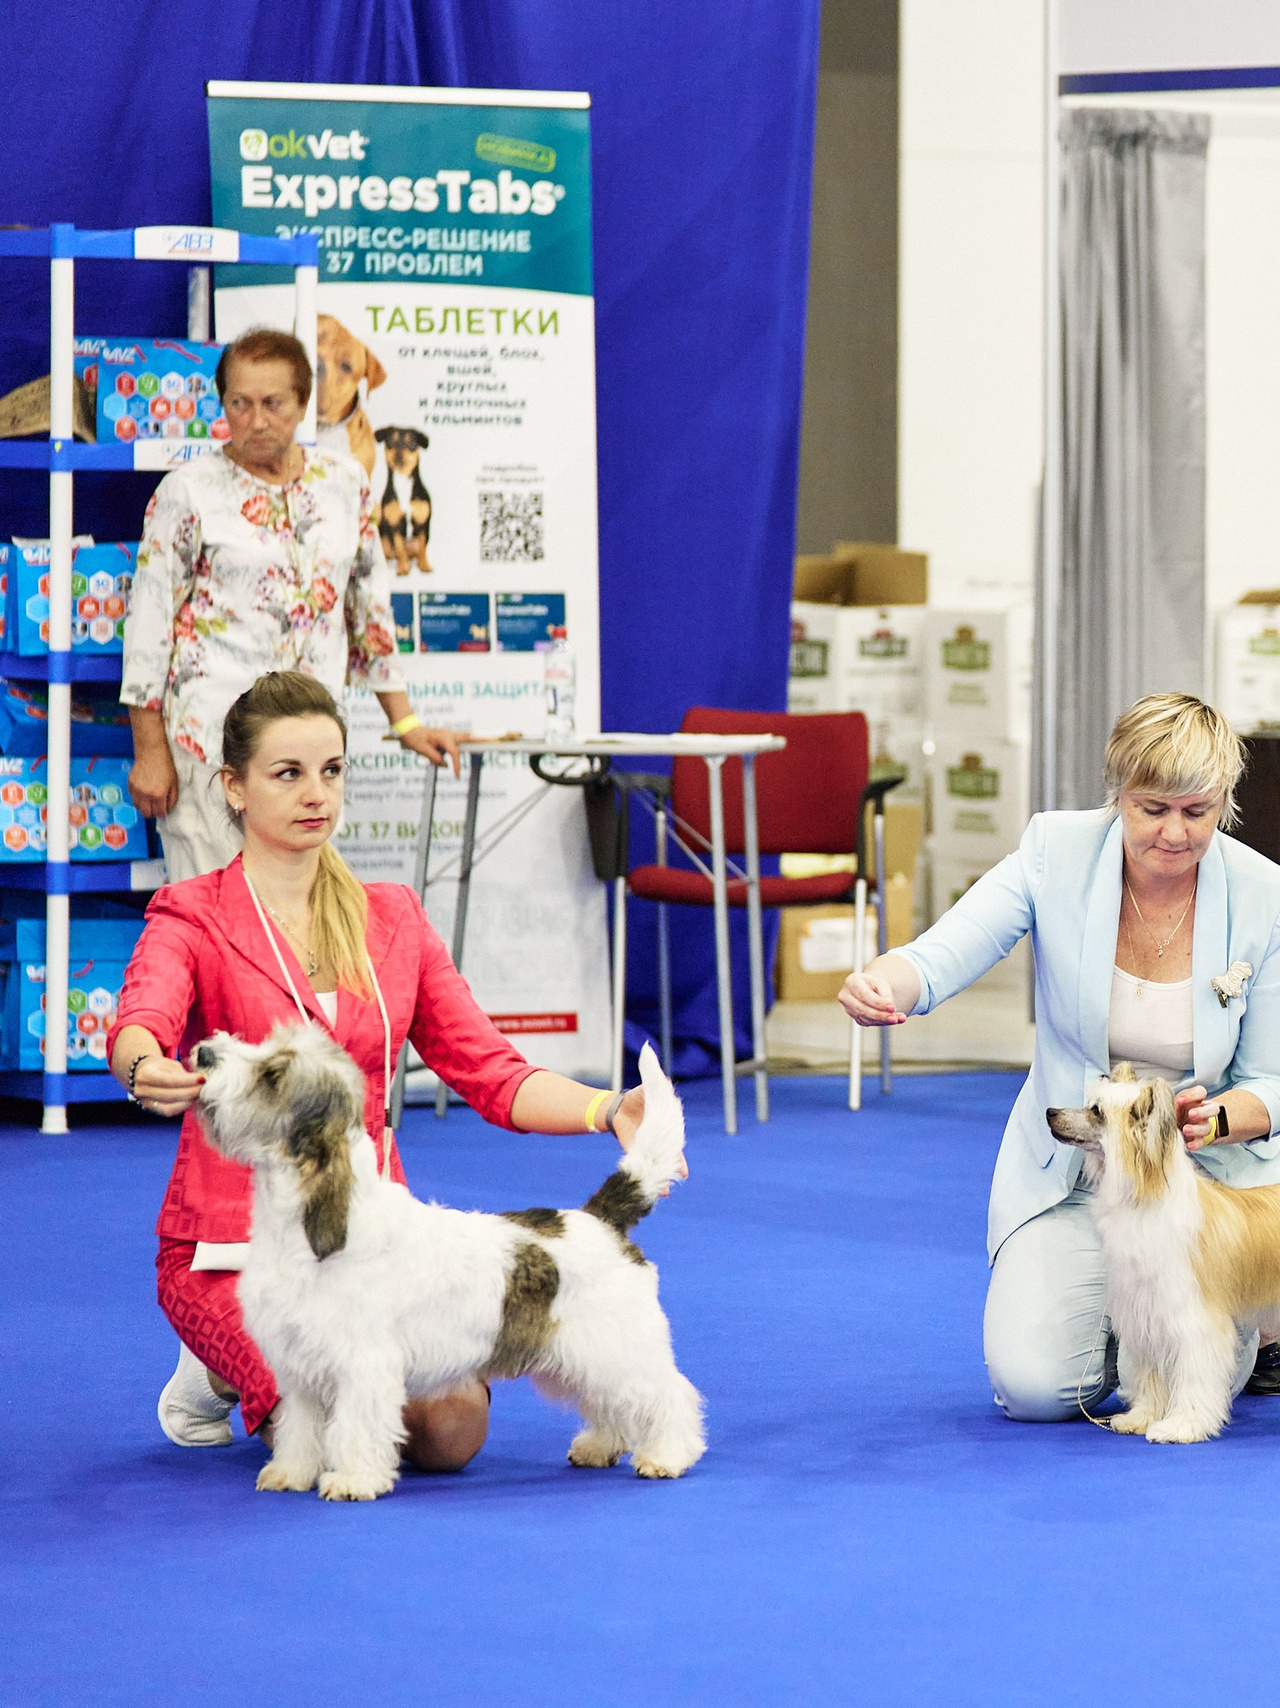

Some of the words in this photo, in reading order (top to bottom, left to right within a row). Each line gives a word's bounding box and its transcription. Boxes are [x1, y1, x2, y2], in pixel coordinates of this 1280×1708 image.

[326, 251, 355, 274] 37
[364, 252, 484, 276] ПРОБЛЕМ
[366, 306, 560, 335] ТАБЛЕТКИ
